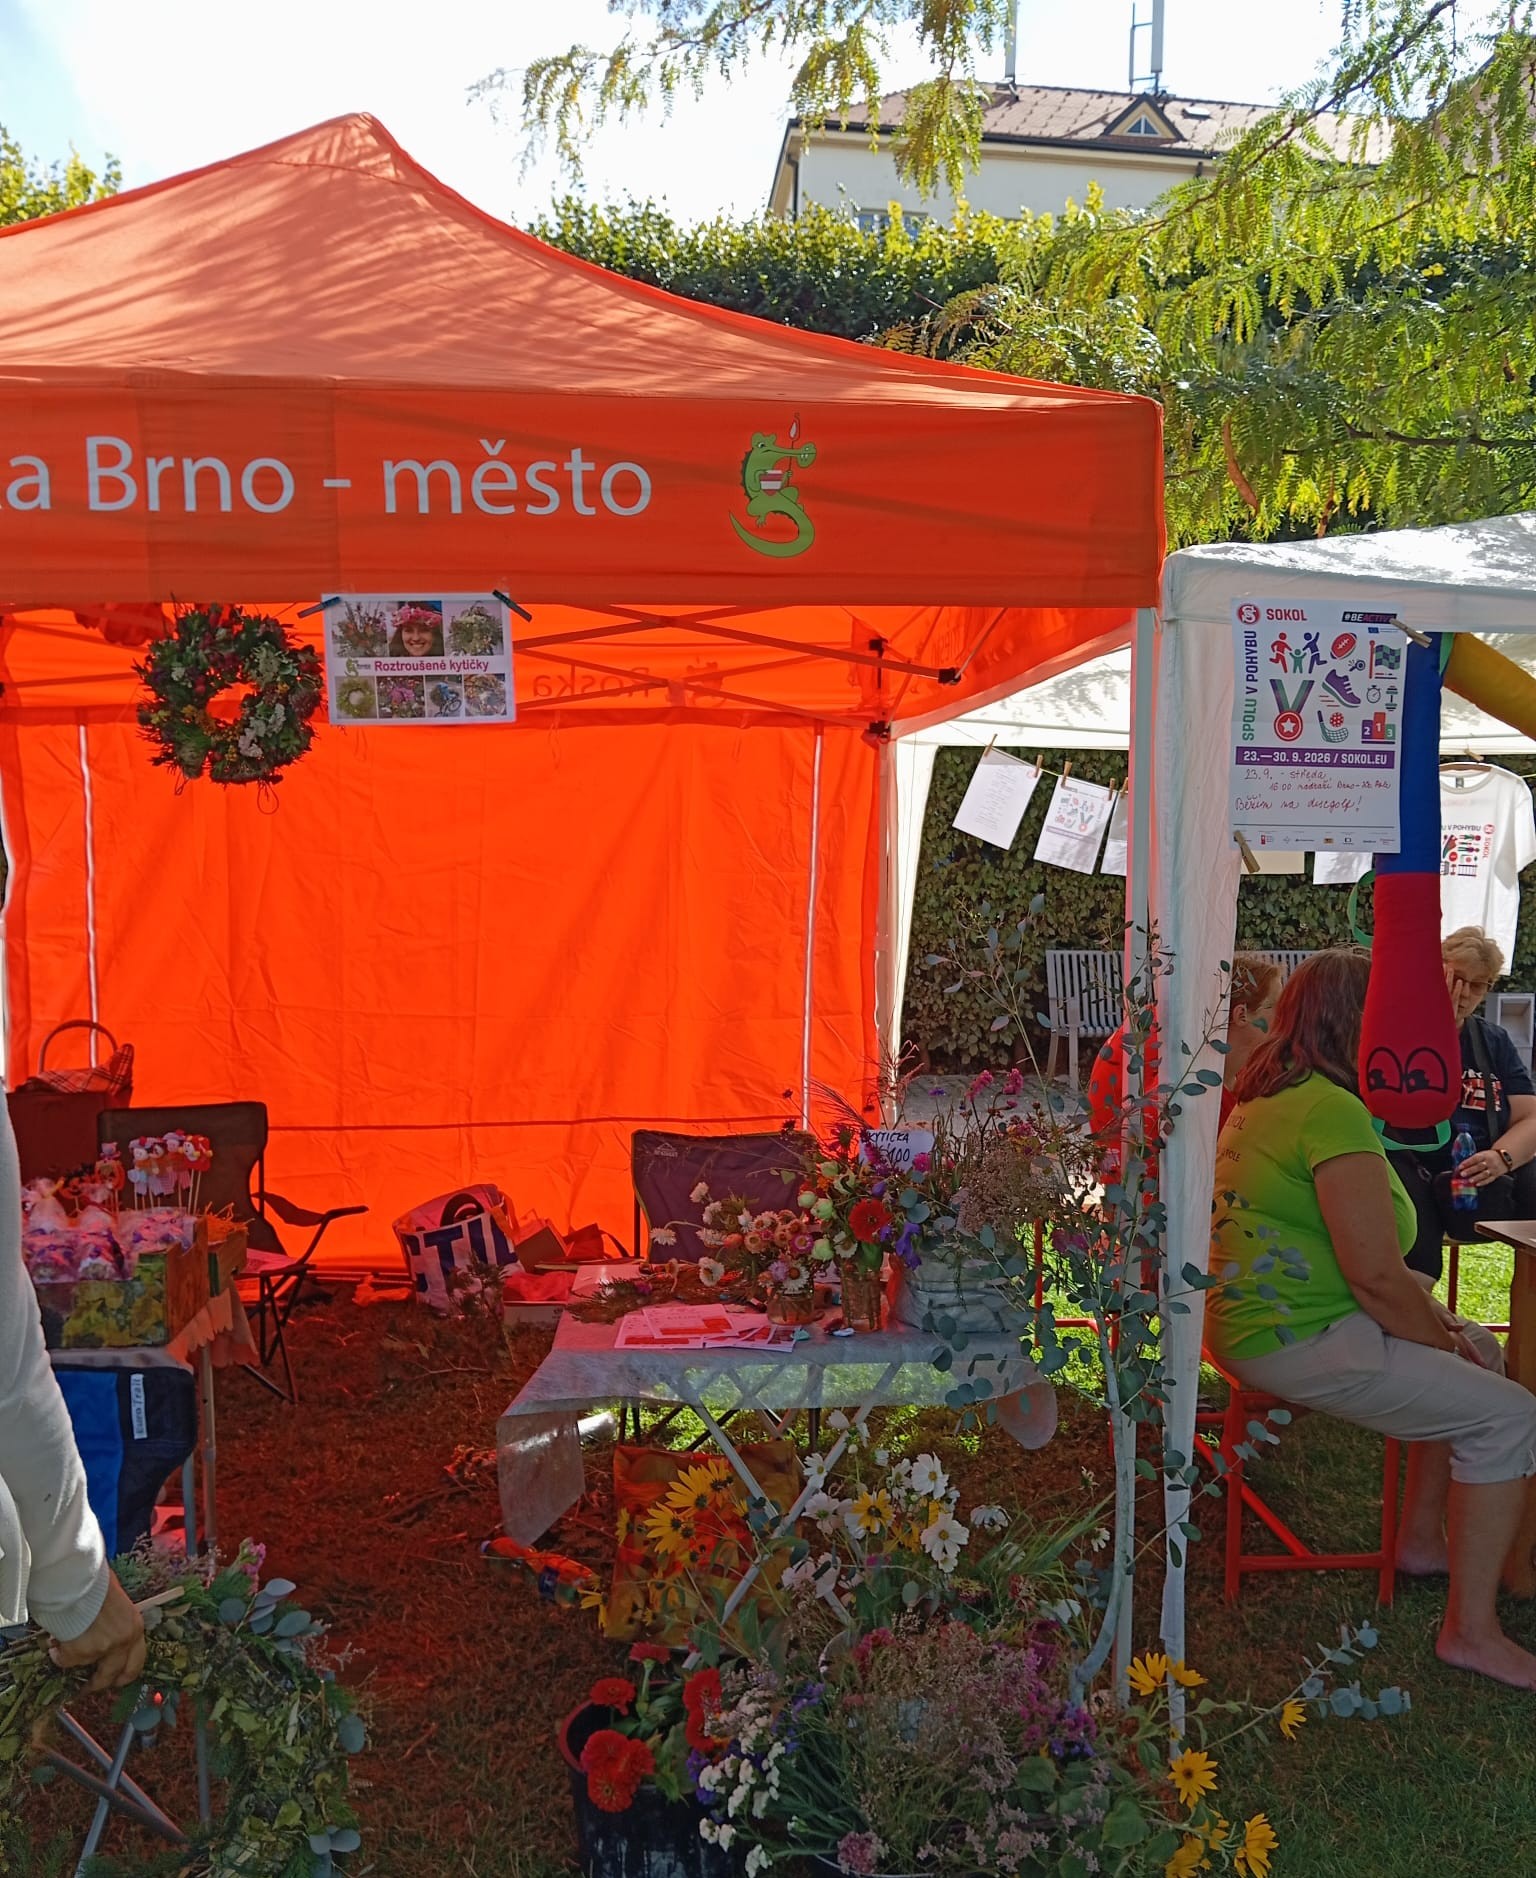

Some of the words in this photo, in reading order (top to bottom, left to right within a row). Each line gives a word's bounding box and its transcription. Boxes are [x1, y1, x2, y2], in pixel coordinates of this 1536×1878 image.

[0, 455, 51, 510] a
[86, 436, 295, 513] Brno
[383, 439, 652, 516] město
[1266, 608, 1308, 621] SOKOL
[1344, 613, 1396, 624] #BEACTIV
[1244, 630, 1258, 682] POHYBU
[374, 660, 447, 672] Roztroušené
[449, 659, 489, 673] kytičky
[1245, 685, 1258, 695] V
[1241, 698, 1257, 742] SPOLU
[1363, 726, 1371, 735] 2
[1292, 752, 1302, 763] 9.
[1304, 753, 1331, 764] 2026
[1341, 754, 1388, 765] SOKOL.EU
